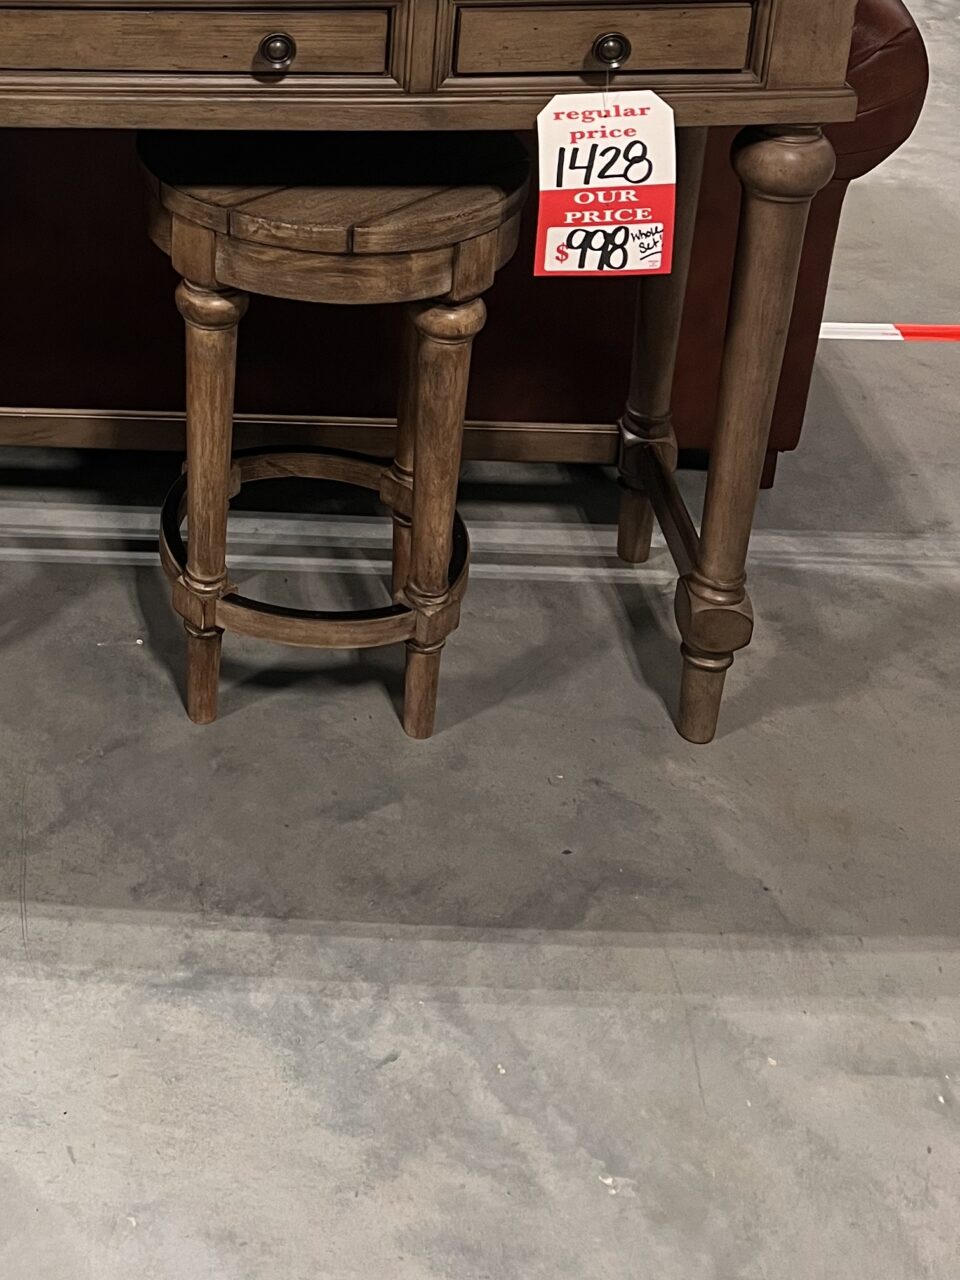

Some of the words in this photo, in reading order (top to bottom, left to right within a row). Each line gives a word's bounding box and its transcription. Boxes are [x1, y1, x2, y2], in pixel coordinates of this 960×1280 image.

[553, 105, 651, 123] regular
[569, 125, 637, 144] price
[556, 140, 653, 187] 1428
[573, 189, 639, 205] OUR
[563, 207, 653, 223] PRICE
